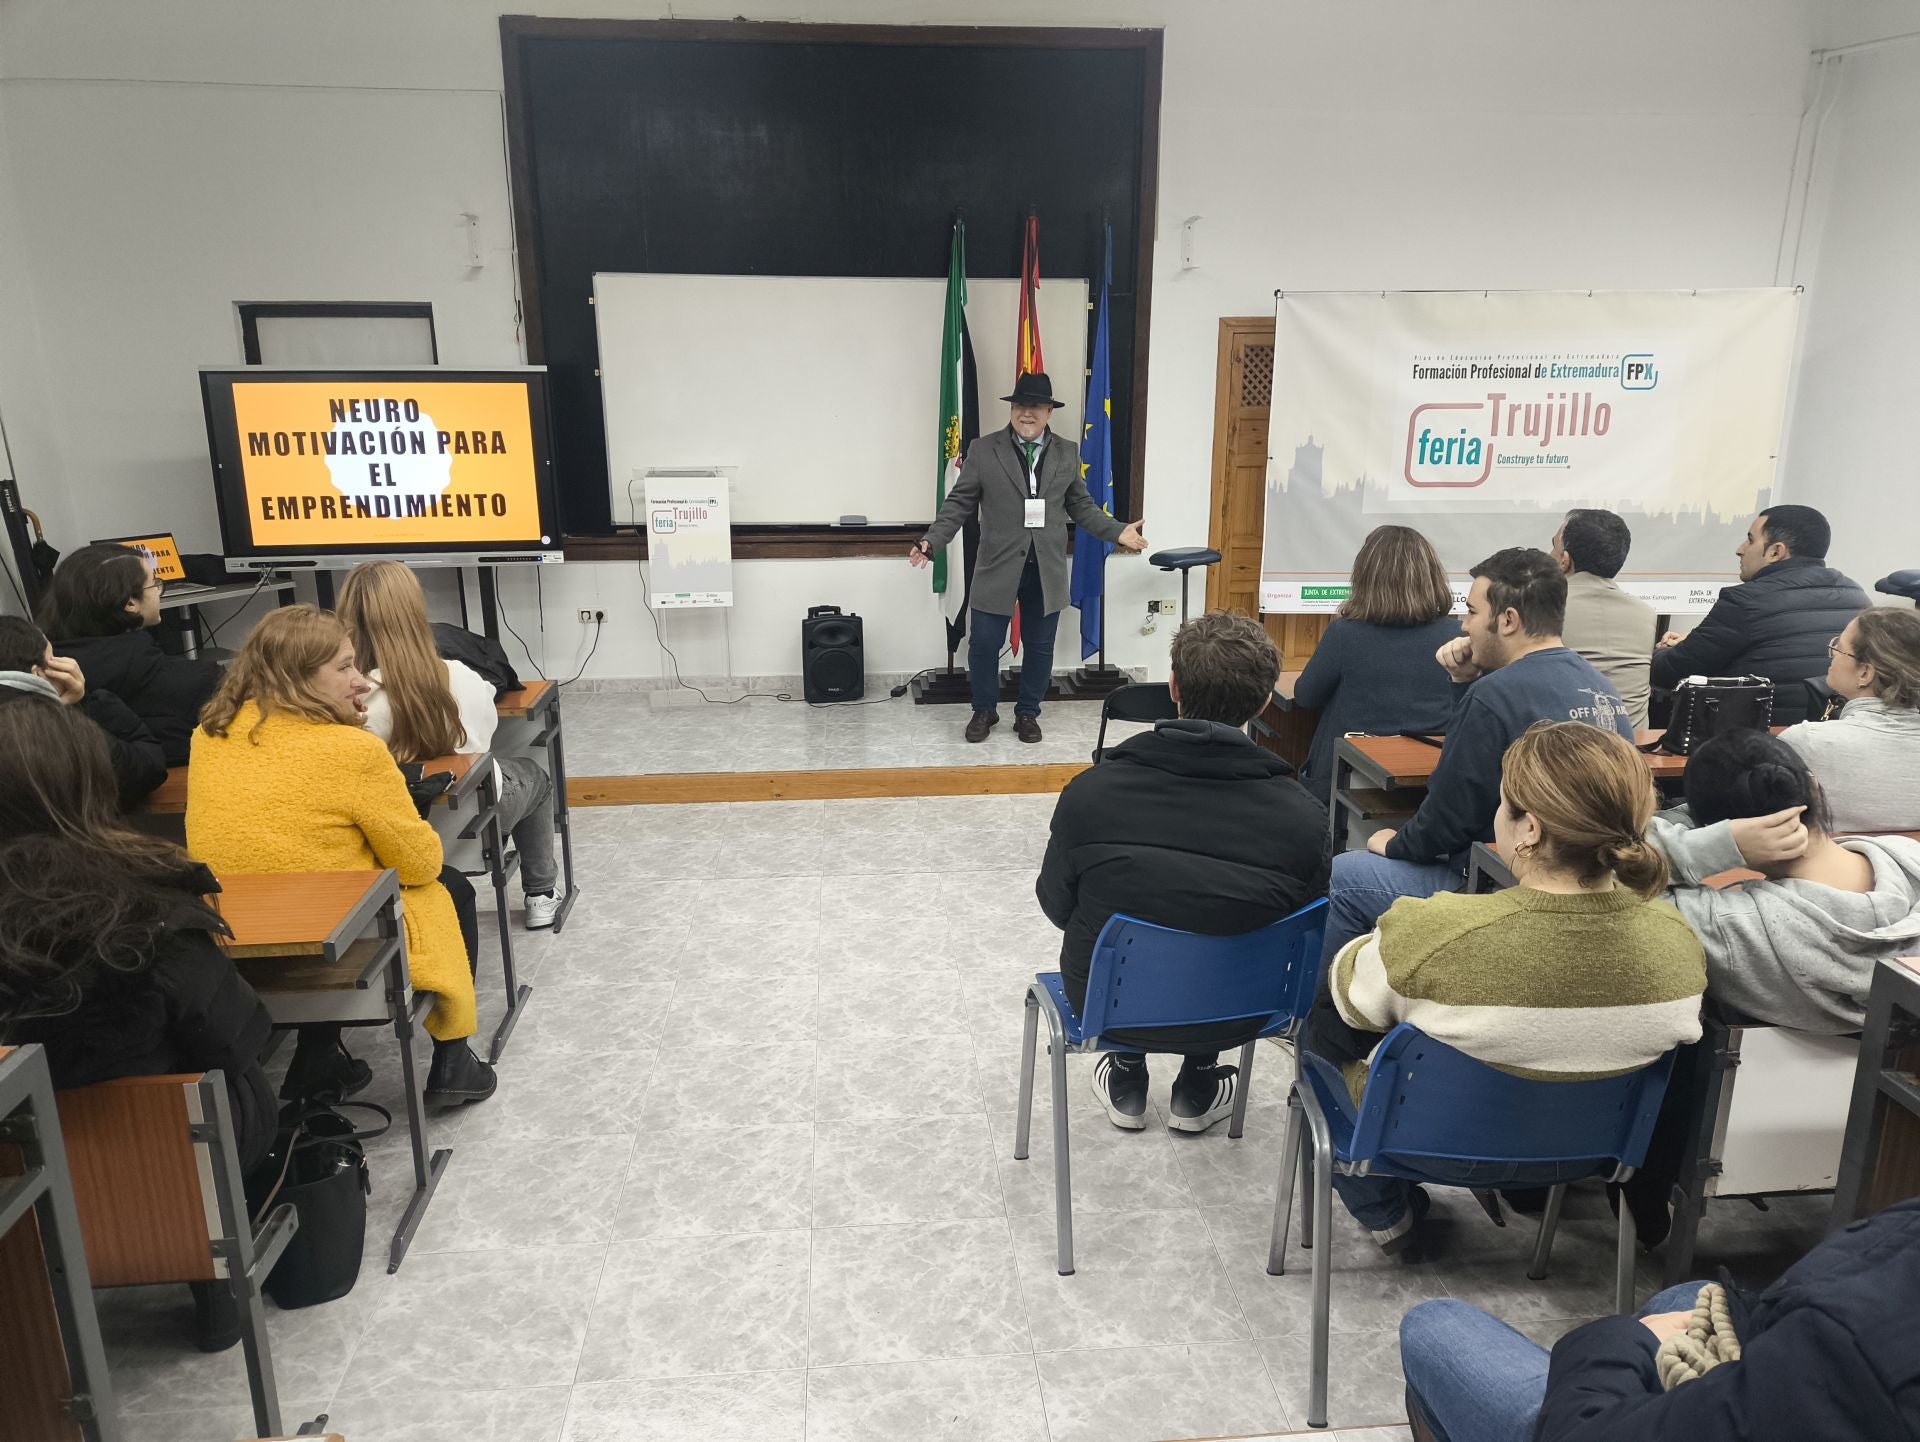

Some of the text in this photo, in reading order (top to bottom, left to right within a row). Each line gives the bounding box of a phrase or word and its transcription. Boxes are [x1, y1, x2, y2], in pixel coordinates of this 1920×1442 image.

[1412, 362, 1619, 379] Formación Profesional de Extremadura
[1627, 363, 1654, 380] FPX
[329, 398, 420, 423] NEURO
[1487, 392, 1611, 447] Trujillo
[248, 426, 507, 456] MOTIVACIÓN PARA
[1418, 428, 1482, 465] feria
[1497, 453, 1569, 467] Construye tu futuro
[369, 463, 397, 487] EL
[262, 493, 507, 520] EMPRENDIMIENTO
[673, 507, 708, 523] Trujillo
[655, 516, 673, 528] feria
[151, 550, 170, 558] PARA
[1267, 592, 1292, 600] Organiza
[1304, 588, 1319, 596] JUNTA
[1321, 588, 1328, 596] DE
[1569, 706, 1590, 720] OFF
